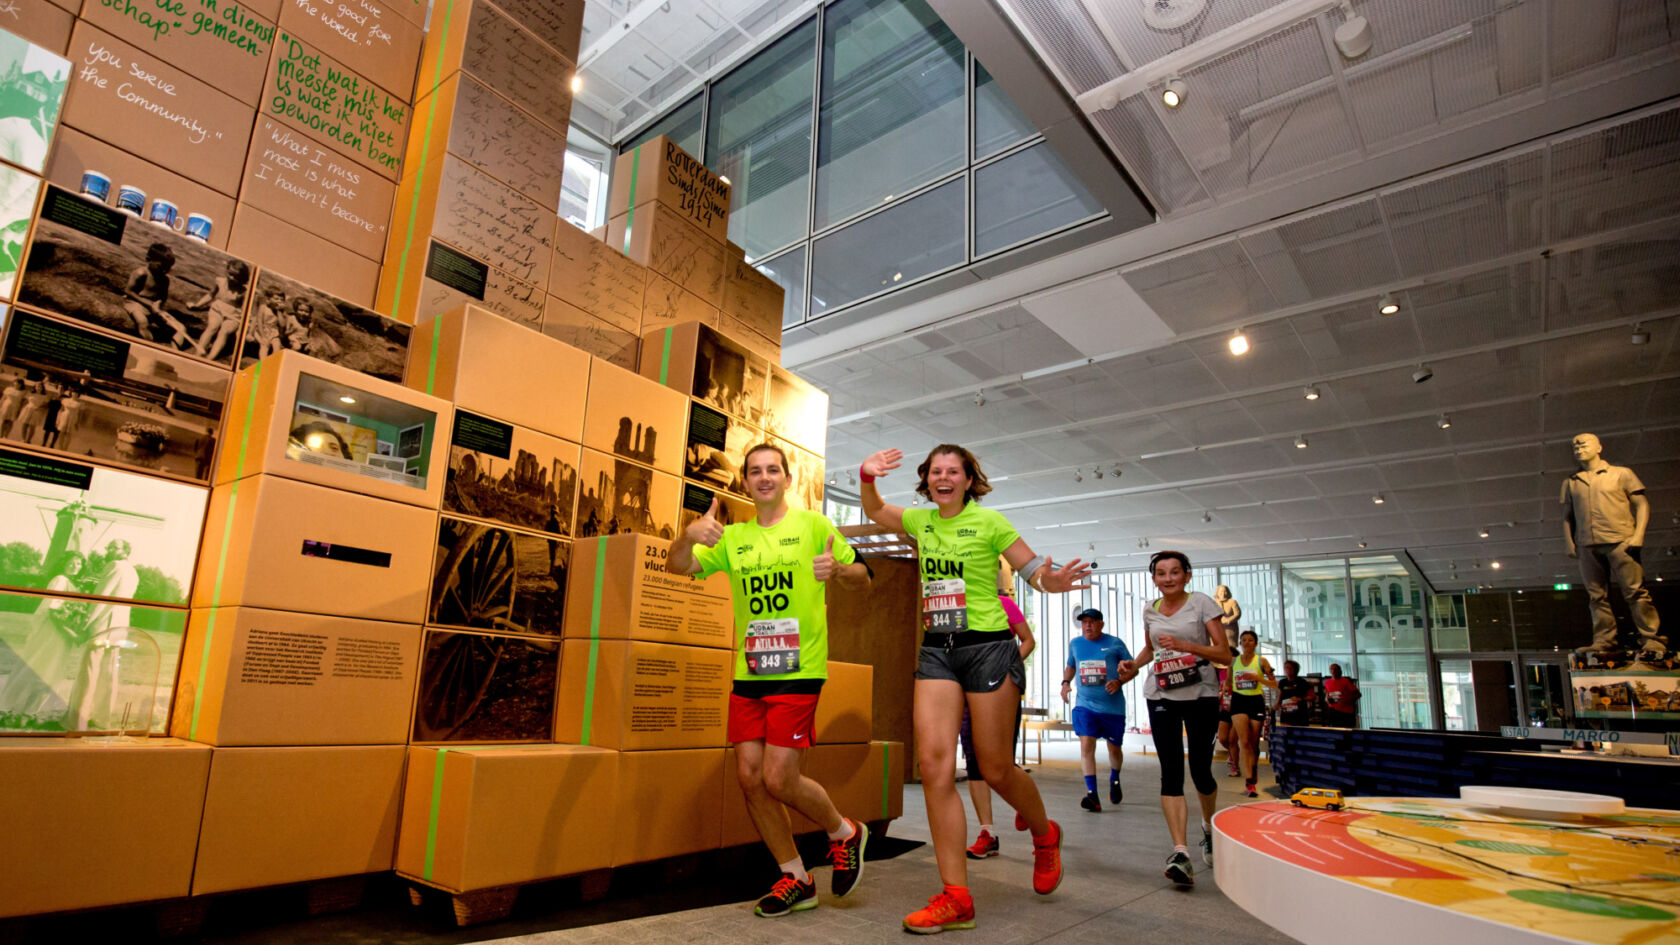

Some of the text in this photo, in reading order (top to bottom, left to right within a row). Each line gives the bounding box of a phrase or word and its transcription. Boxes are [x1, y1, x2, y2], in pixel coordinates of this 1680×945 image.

[223, 5, 276, 44] dienst
[337, 4, 368, 26] good
[184, 12, 263, 56] gemeen-
[80, 65, 108, 89] the
[278, 57, 374, 121] meeste mis
[328, 67, 359, 96] wat
[362, 86, 380, 109] ik
[383, 96, 405, 125] het
[271, 96, 363, 152] geworden
[298, 88, 331, 114] wat
[337, 104, 352, 126] ik
[359, 120, 394, 147] niet
[254, 162, 273, 180] I
[263, 148, 357, 200] most is what
[310, 150, 326, 167] I
[327, 161, 361, 185] miss
[679, 193, 712, 228] 1914
[645, 545, 667, 559] 23.0
[925, 557, 963, 579] RUN
[742, 571, 794, 596] I RUN
[933, 613, 950, 627] 344
[761, 654, 781, 668] 343
[1168, 673, 1184, 684] 280
[1563, 729, 1620, 743] MARCO
[1664, 734, 1680, 746] IN
